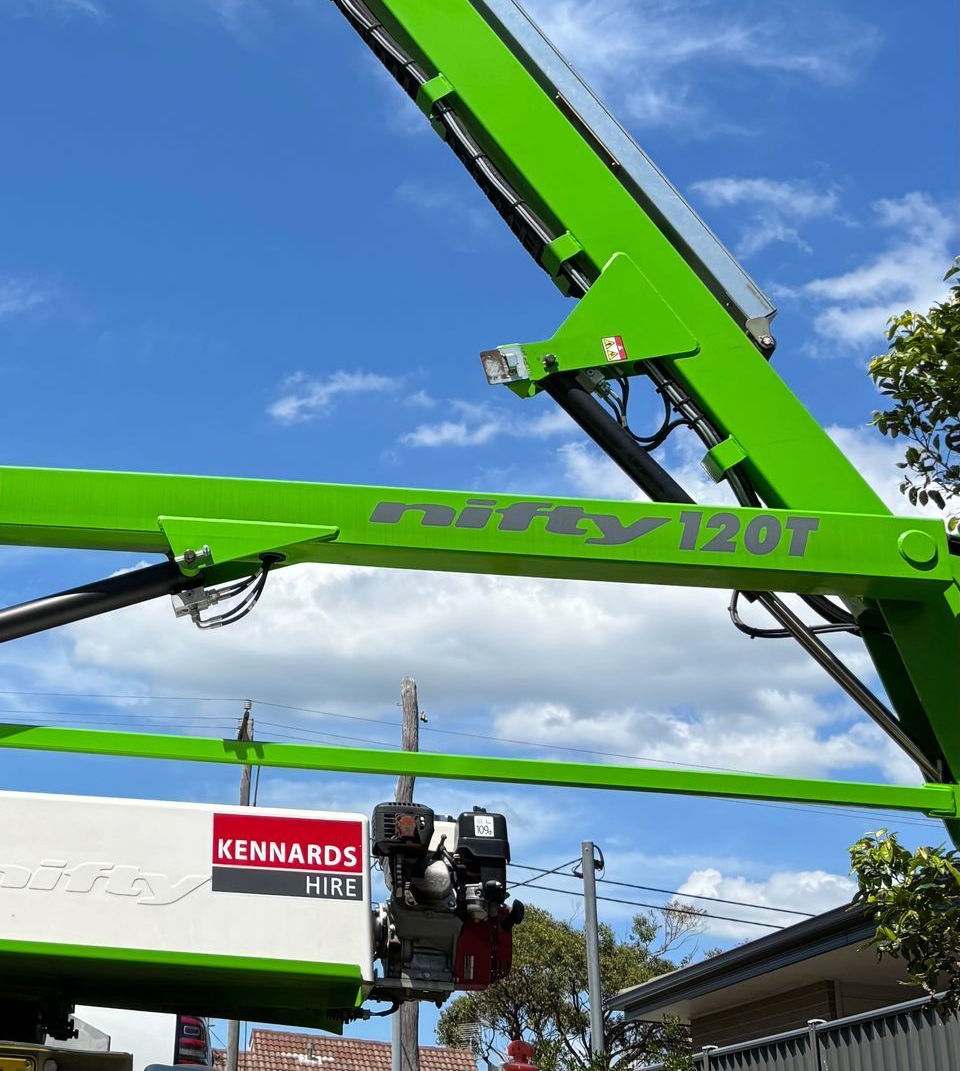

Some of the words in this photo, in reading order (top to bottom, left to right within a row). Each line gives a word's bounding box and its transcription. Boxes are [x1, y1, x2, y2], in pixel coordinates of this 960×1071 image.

[370, 499, 673, 546] nifty
[678, 510, 820, 557] 120T
[216, 838, 358, 867] KENNARDS
[306, 875, 357, 897] HIRE
